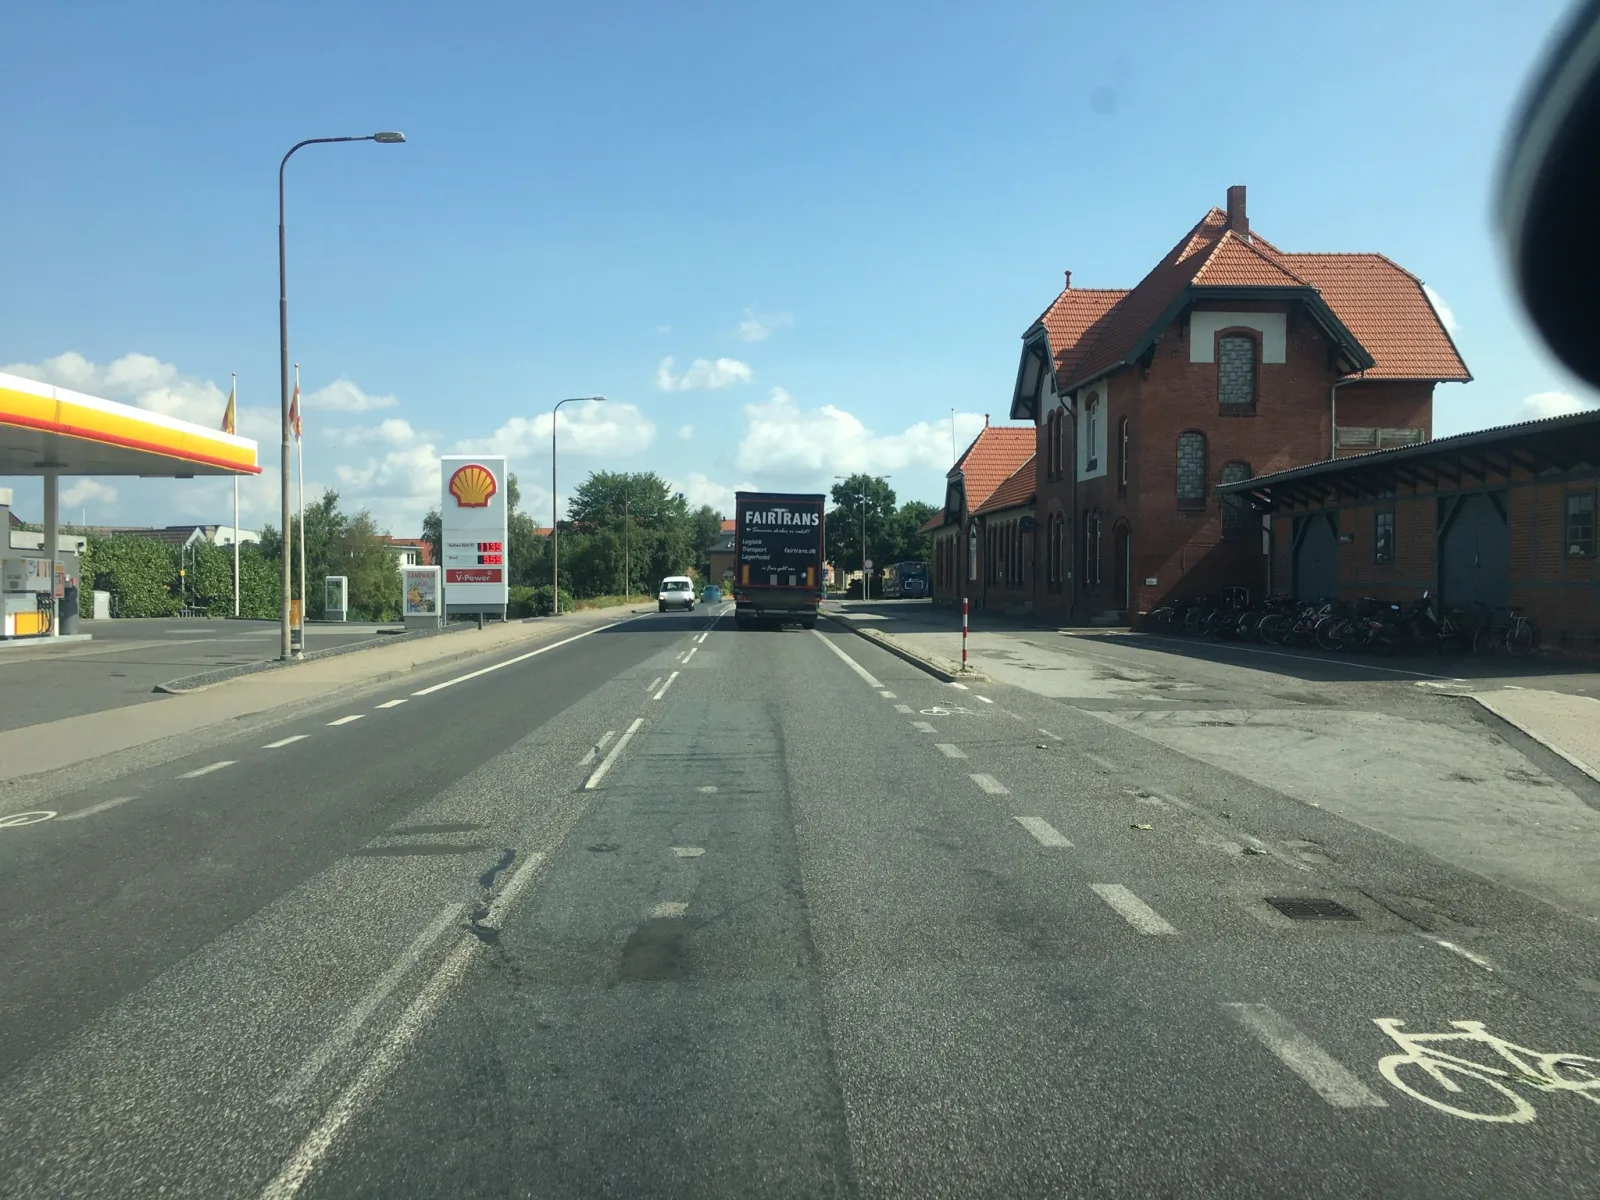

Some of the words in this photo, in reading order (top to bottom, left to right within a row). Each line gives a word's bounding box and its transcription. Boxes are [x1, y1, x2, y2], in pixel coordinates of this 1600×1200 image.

[745, 508, 819, 526] FAIRTRANS
[741, 538, 762, 546] Logistik
[784, 546, 816, 554] fairtrans.dk
